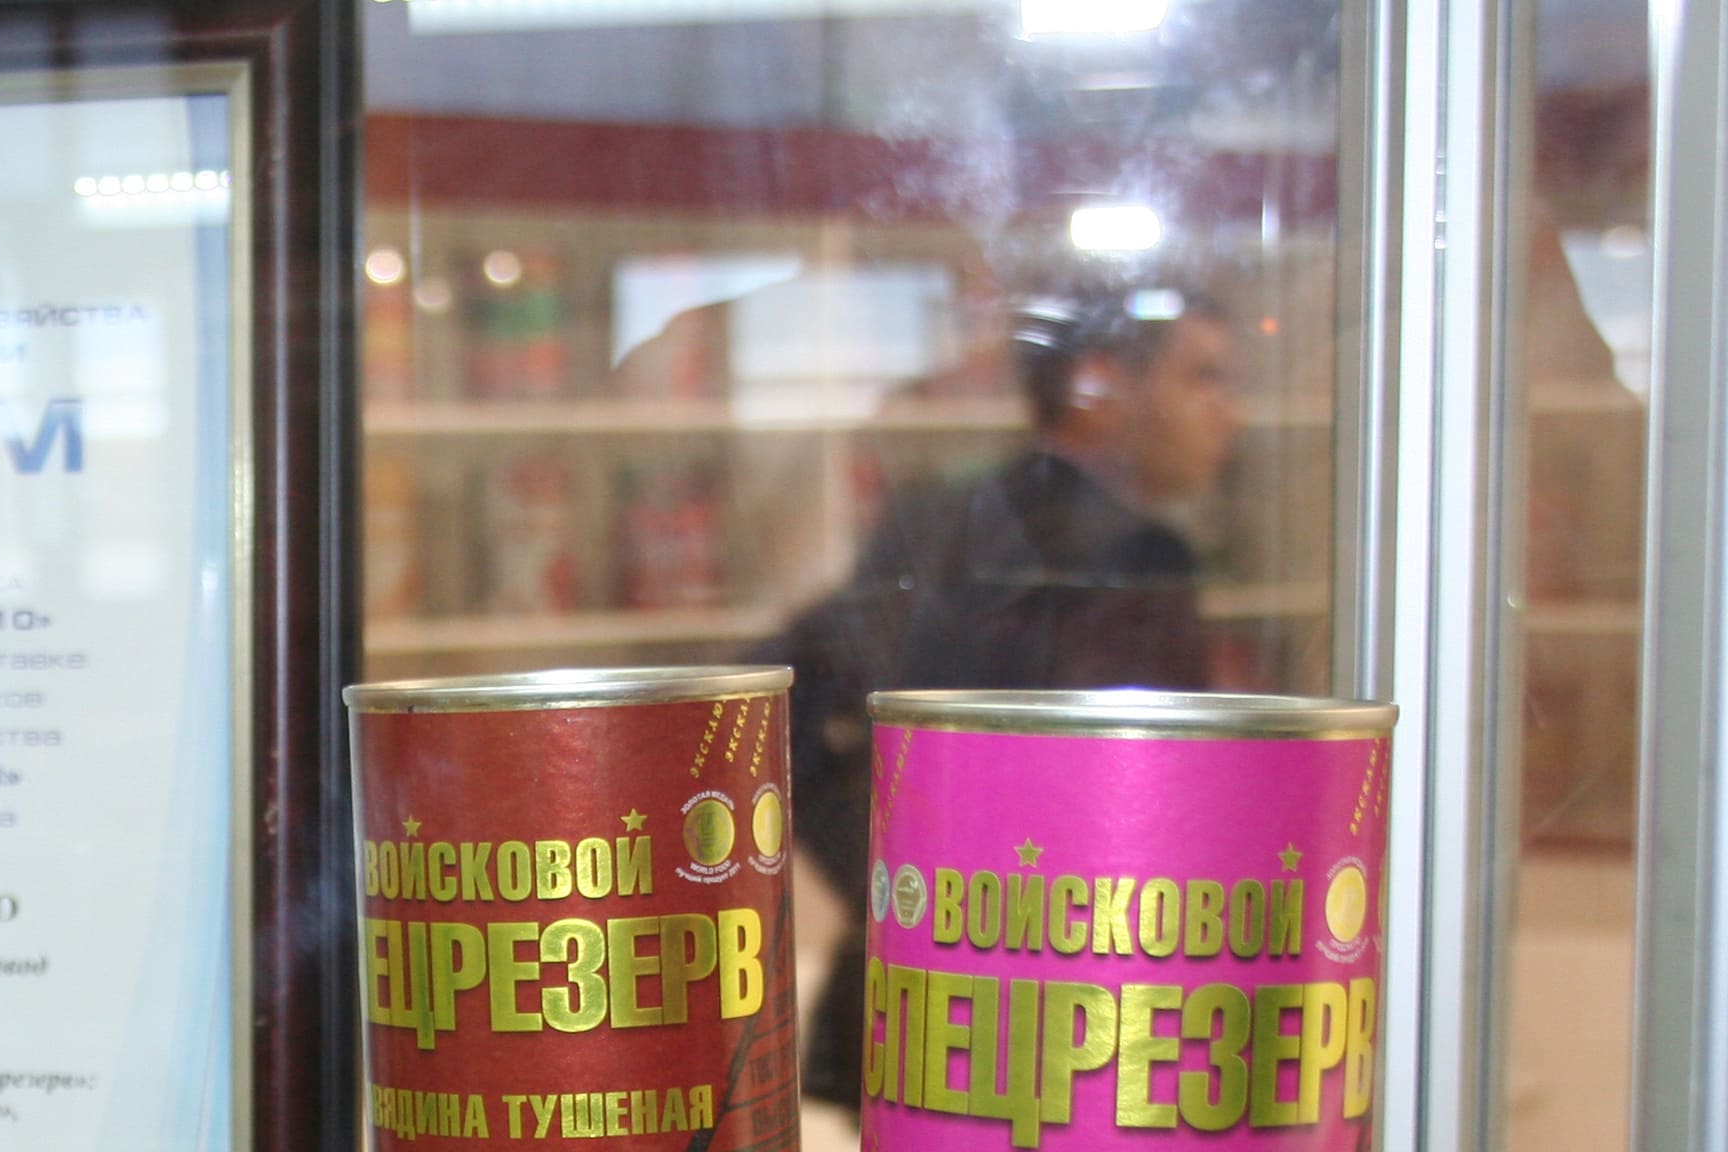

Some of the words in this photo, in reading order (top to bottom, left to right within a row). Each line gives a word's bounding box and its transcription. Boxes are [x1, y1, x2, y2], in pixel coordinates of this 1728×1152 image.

[365, 836, 652, 901] ВОЙСКОВОЙ
[933, 868, 1305, 957] ВОЙСКОВОЙ
[864, 955, 1375, 1150] СПЕЦРЕЗЕРВ
[502, 1085, 713, 1139] ТУШЕНАЯ
